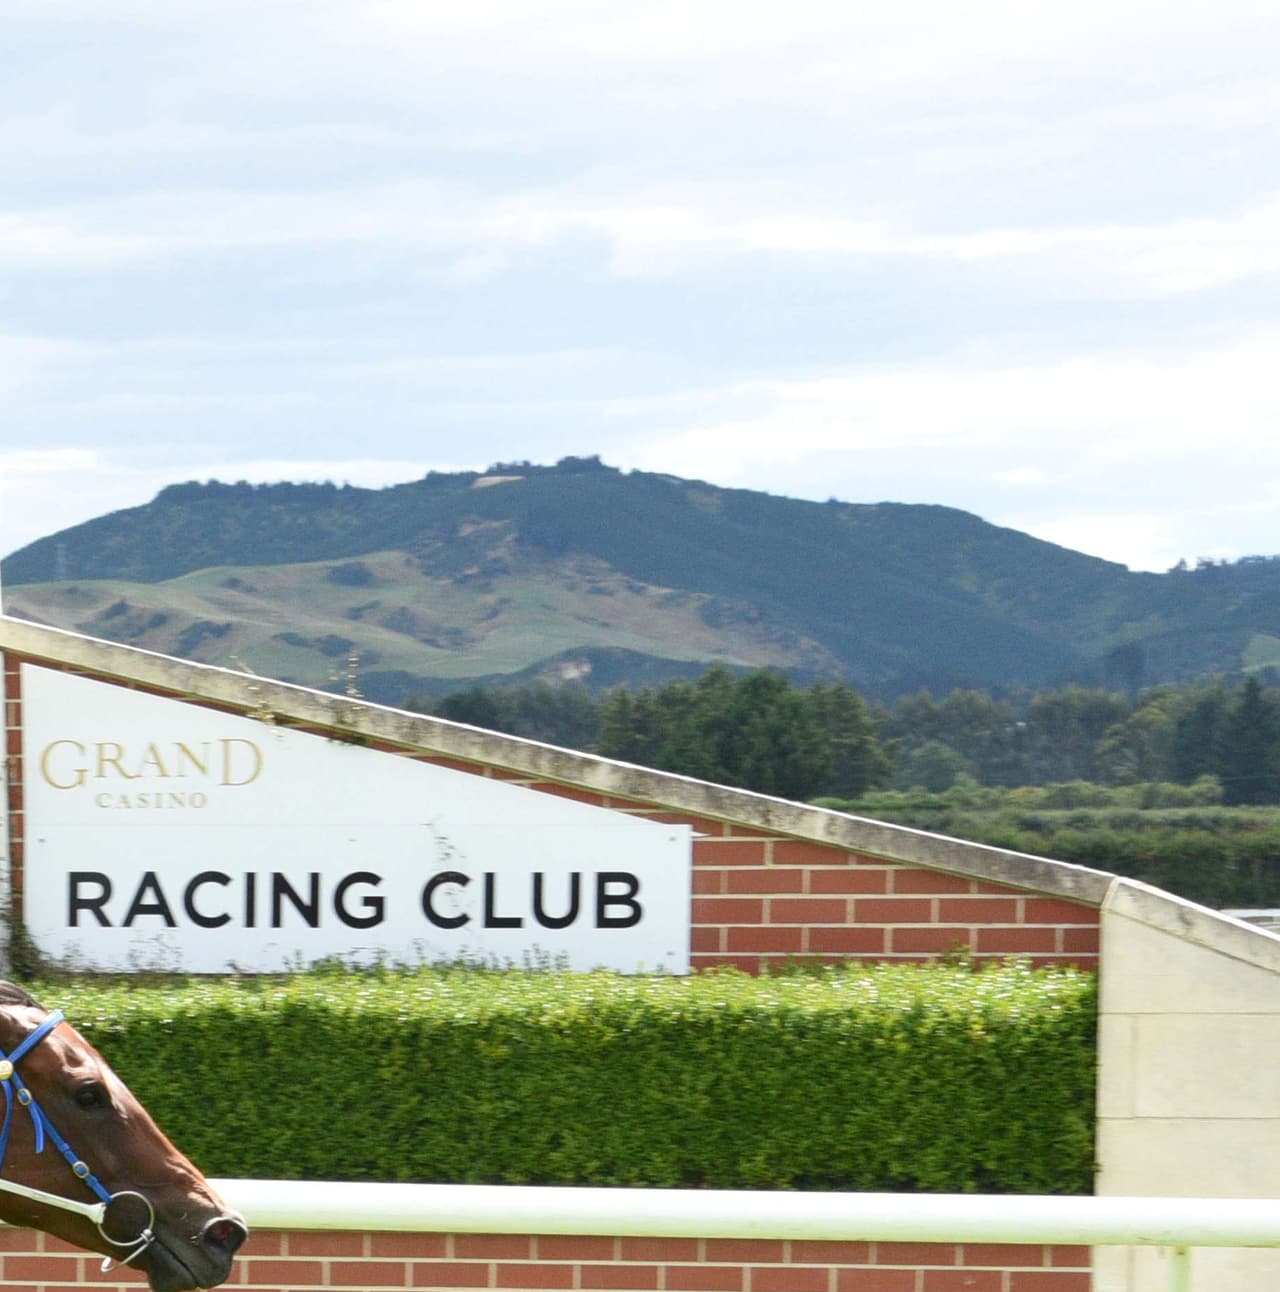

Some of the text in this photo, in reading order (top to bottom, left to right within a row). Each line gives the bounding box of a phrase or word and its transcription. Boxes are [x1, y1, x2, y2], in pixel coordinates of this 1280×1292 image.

[39, 739, 264, 790] GRAND
[95, 792, 208, 809] CASINO
[68, 871, 643, 929] RACING CLUB
